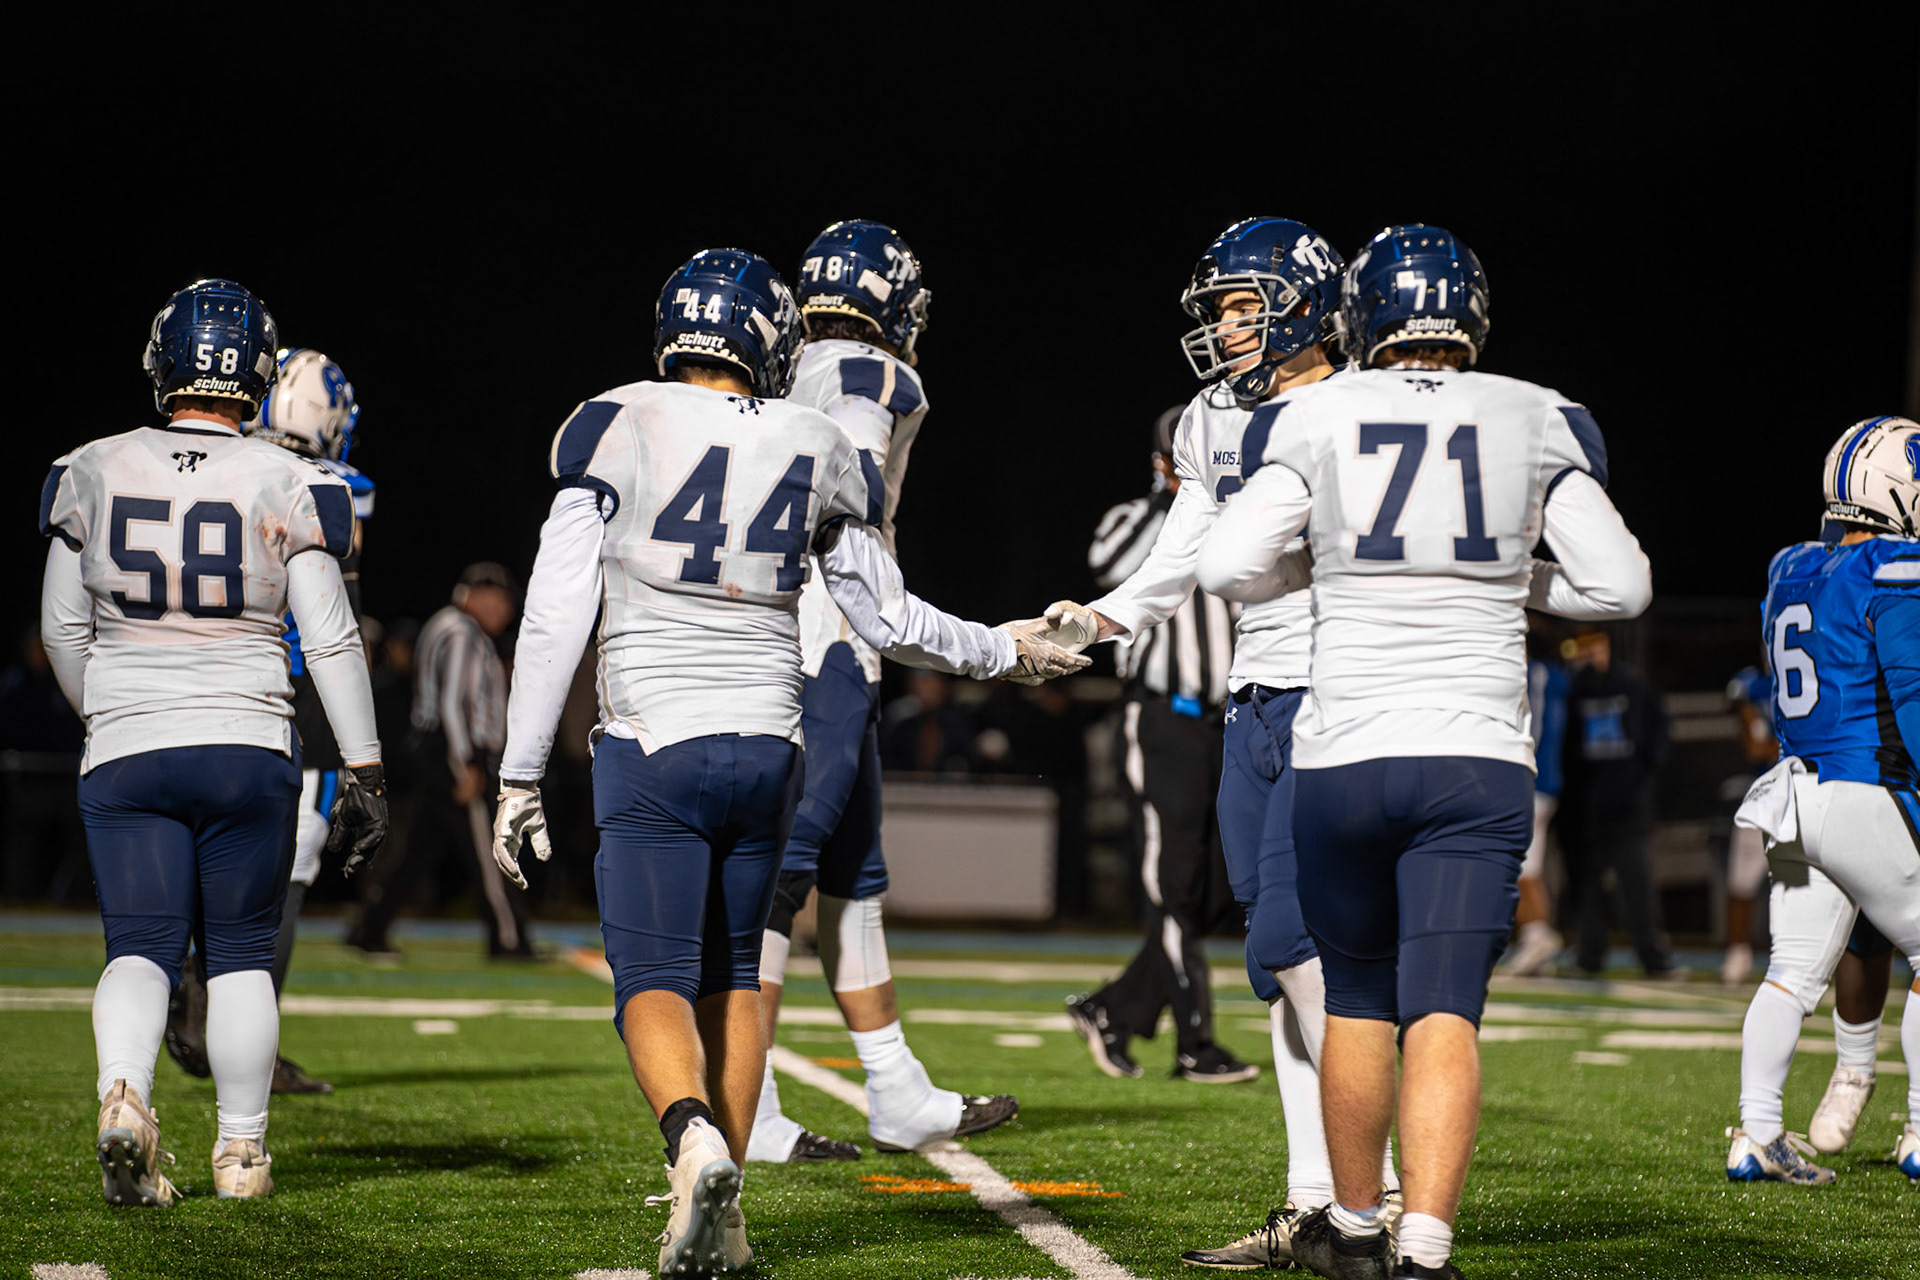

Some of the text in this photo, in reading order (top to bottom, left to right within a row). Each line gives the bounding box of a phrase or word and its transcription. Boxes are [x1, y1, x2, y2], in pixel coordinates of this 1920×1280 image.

[808, 255, 844, 282] 78
[683, 291, 722, 323] 44
[1408, 277, 1448, 311] 71
[677, 330, 727, 349] schutt
[1405, 315, 1458, 332] schutt
[195, 343, 239, 375] 58
[193, 376, 240, 391] schutt
[1352, 419, 1501, 564] 71
[647, 441, 821, 596] 44
[107, 491, 247, 621] 58
[1773, 602, 1820, 720] 6
